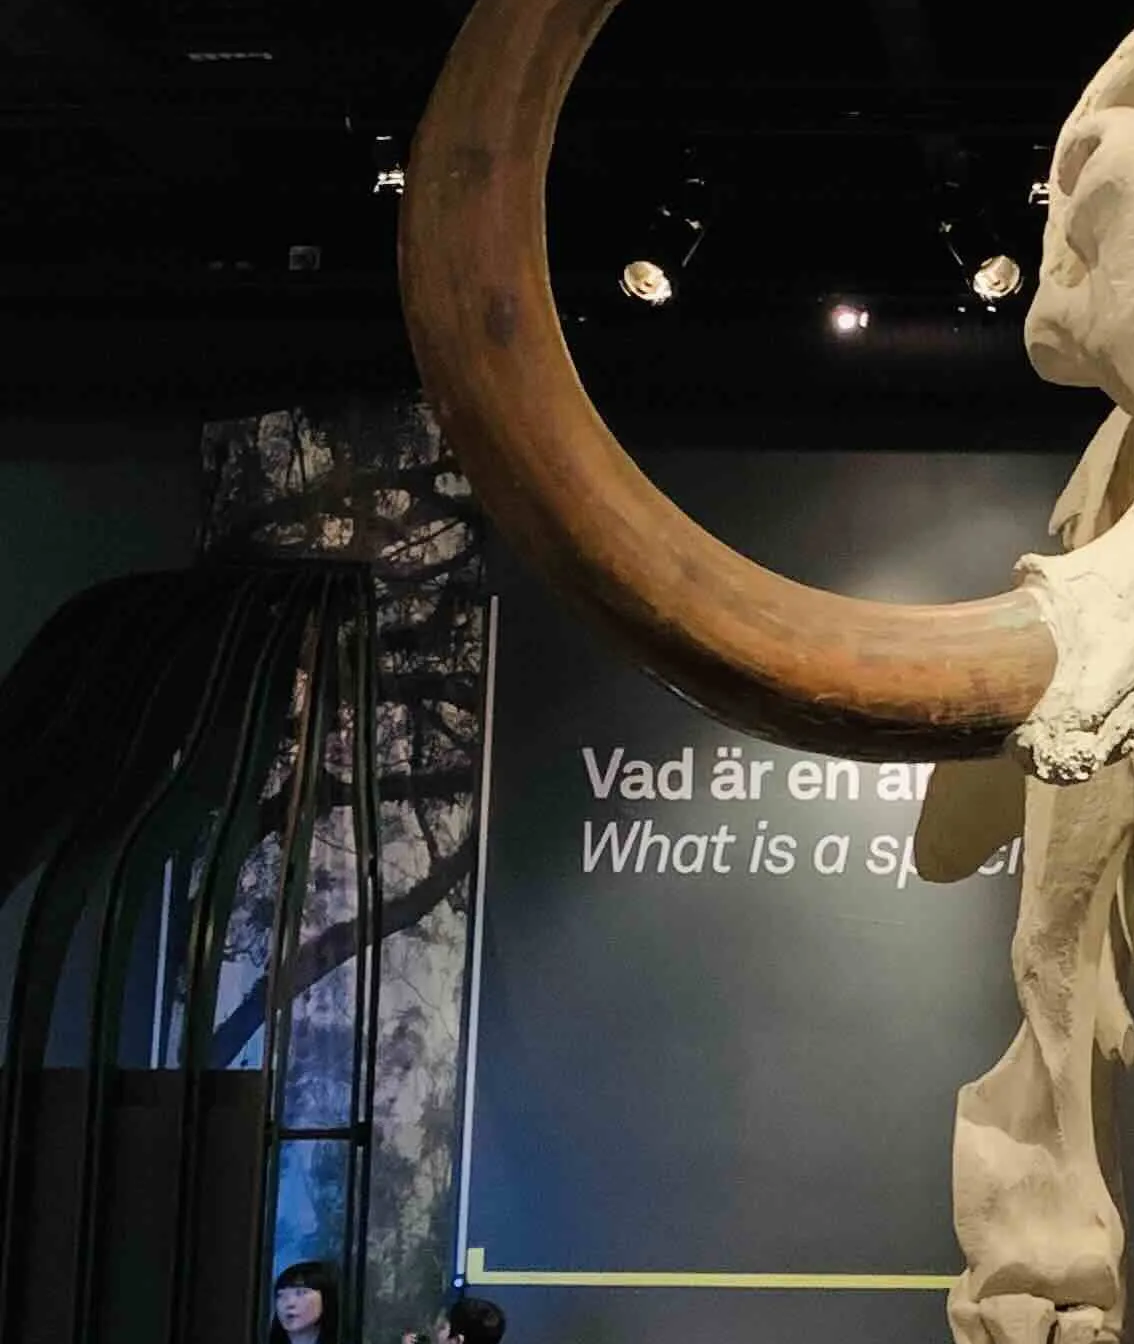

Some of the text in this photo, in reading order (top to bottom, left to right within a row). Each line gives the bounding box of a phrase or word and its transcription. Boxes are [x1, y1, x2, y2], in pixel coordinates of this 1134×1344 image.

[582, 747, 694, 801] Vad
[710, 746, 774, 801] är
[787, 760, 860, 801] en
[583, 819, 737, 874] What
[749, 820, 797, 875] is
[813, 834, 850, 875] a
